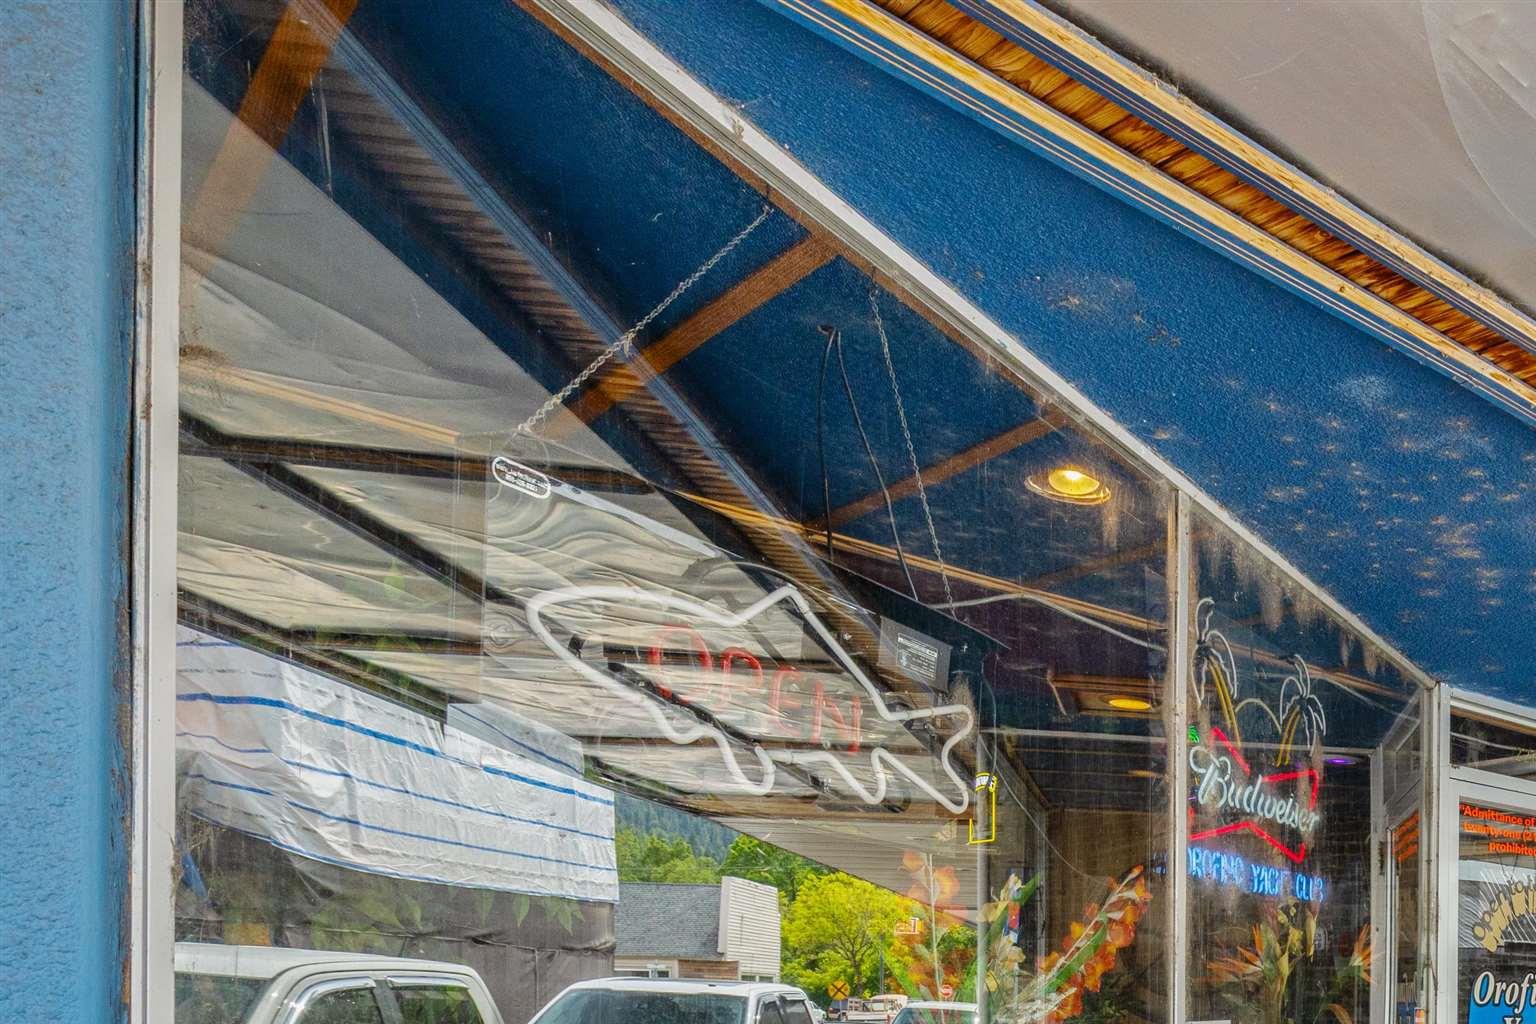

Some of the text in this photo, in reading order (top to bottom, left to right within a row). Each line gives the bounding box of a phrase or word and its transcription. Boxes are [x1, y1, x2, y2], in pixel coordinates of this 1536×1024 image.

[646, 623, 863, 757] OPEN
[1190, 746, 1319, 832] Budweiser
[1525, 817, 1536, 828] of
